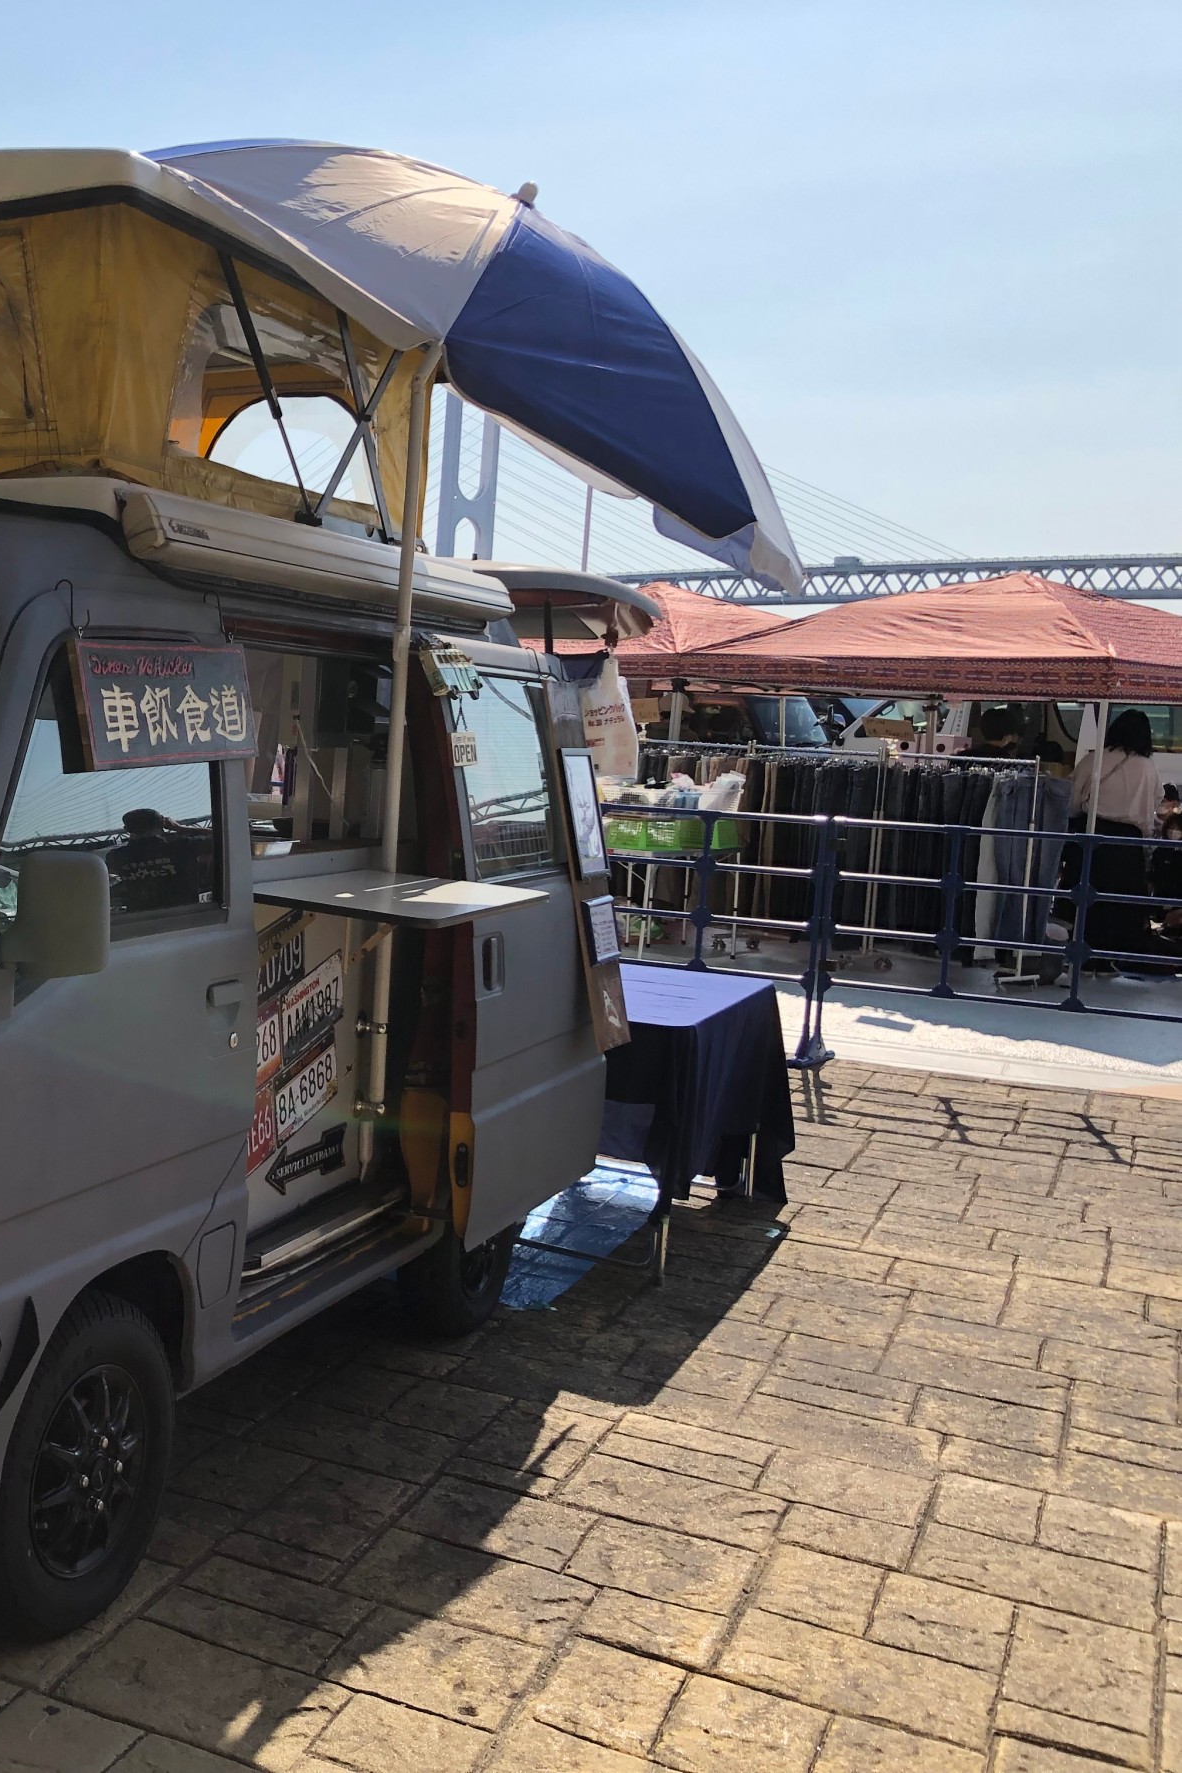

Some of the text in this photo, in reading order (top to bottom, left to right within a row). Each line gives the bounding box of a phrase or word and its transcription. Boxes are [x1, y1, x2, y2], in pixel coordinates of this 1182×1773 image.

[100, 682, 247, 753] 車飲食道
[453, 744, 478, 763] OPEN
[285, 977, 320, 1010] WASHINGTON
[275, 1157, 305, 1180] SERVICE
